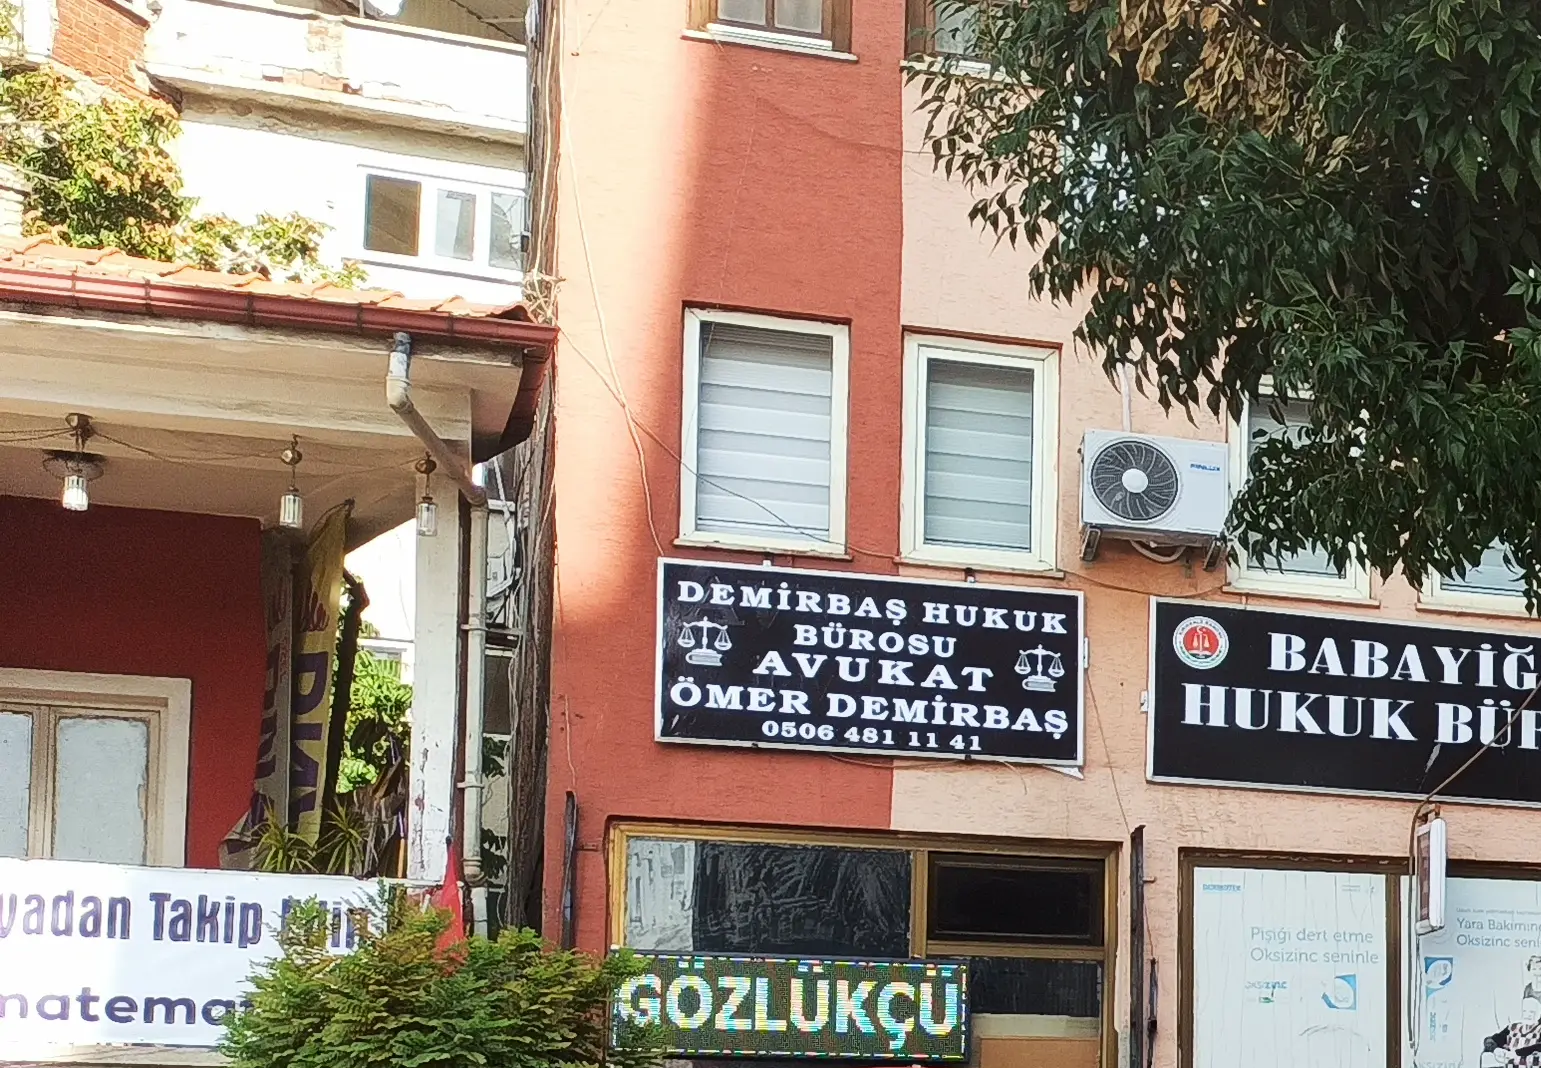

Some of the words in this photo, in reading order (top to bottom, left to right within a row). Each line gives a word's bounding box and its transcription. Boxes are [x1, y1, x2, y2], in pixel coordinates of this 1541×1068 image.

[678, 580, 907, 626] DEMİRBAŞ
[923, 603, 1067, 635] HUKUK
[794, 623, 957, 658] BÜROSU
[753, 650, 993, 692] AVUKAT
[670, 676, 810, 716] ÖMER
[826, 694, 1069, 740] DEMİRBAŞ
[1180, 682, 1417, 742] HUKUK
[762, 720, 833, 741] 0506
[844, 726, 894, 745] 481
[908, 731, 938, 748] 11
[950, 733, 982, 751] 41
[149, 892, 262, 948] Takip
[1297, 928, 1328, 941] dert
[1333, 930, 1373, 943] etme
[1457, 918, 1483, 929] Yara
[1323, 950, 1379, 964] seninle
[615, 956, 960, 1050] GÖZLÜKÇÜ
